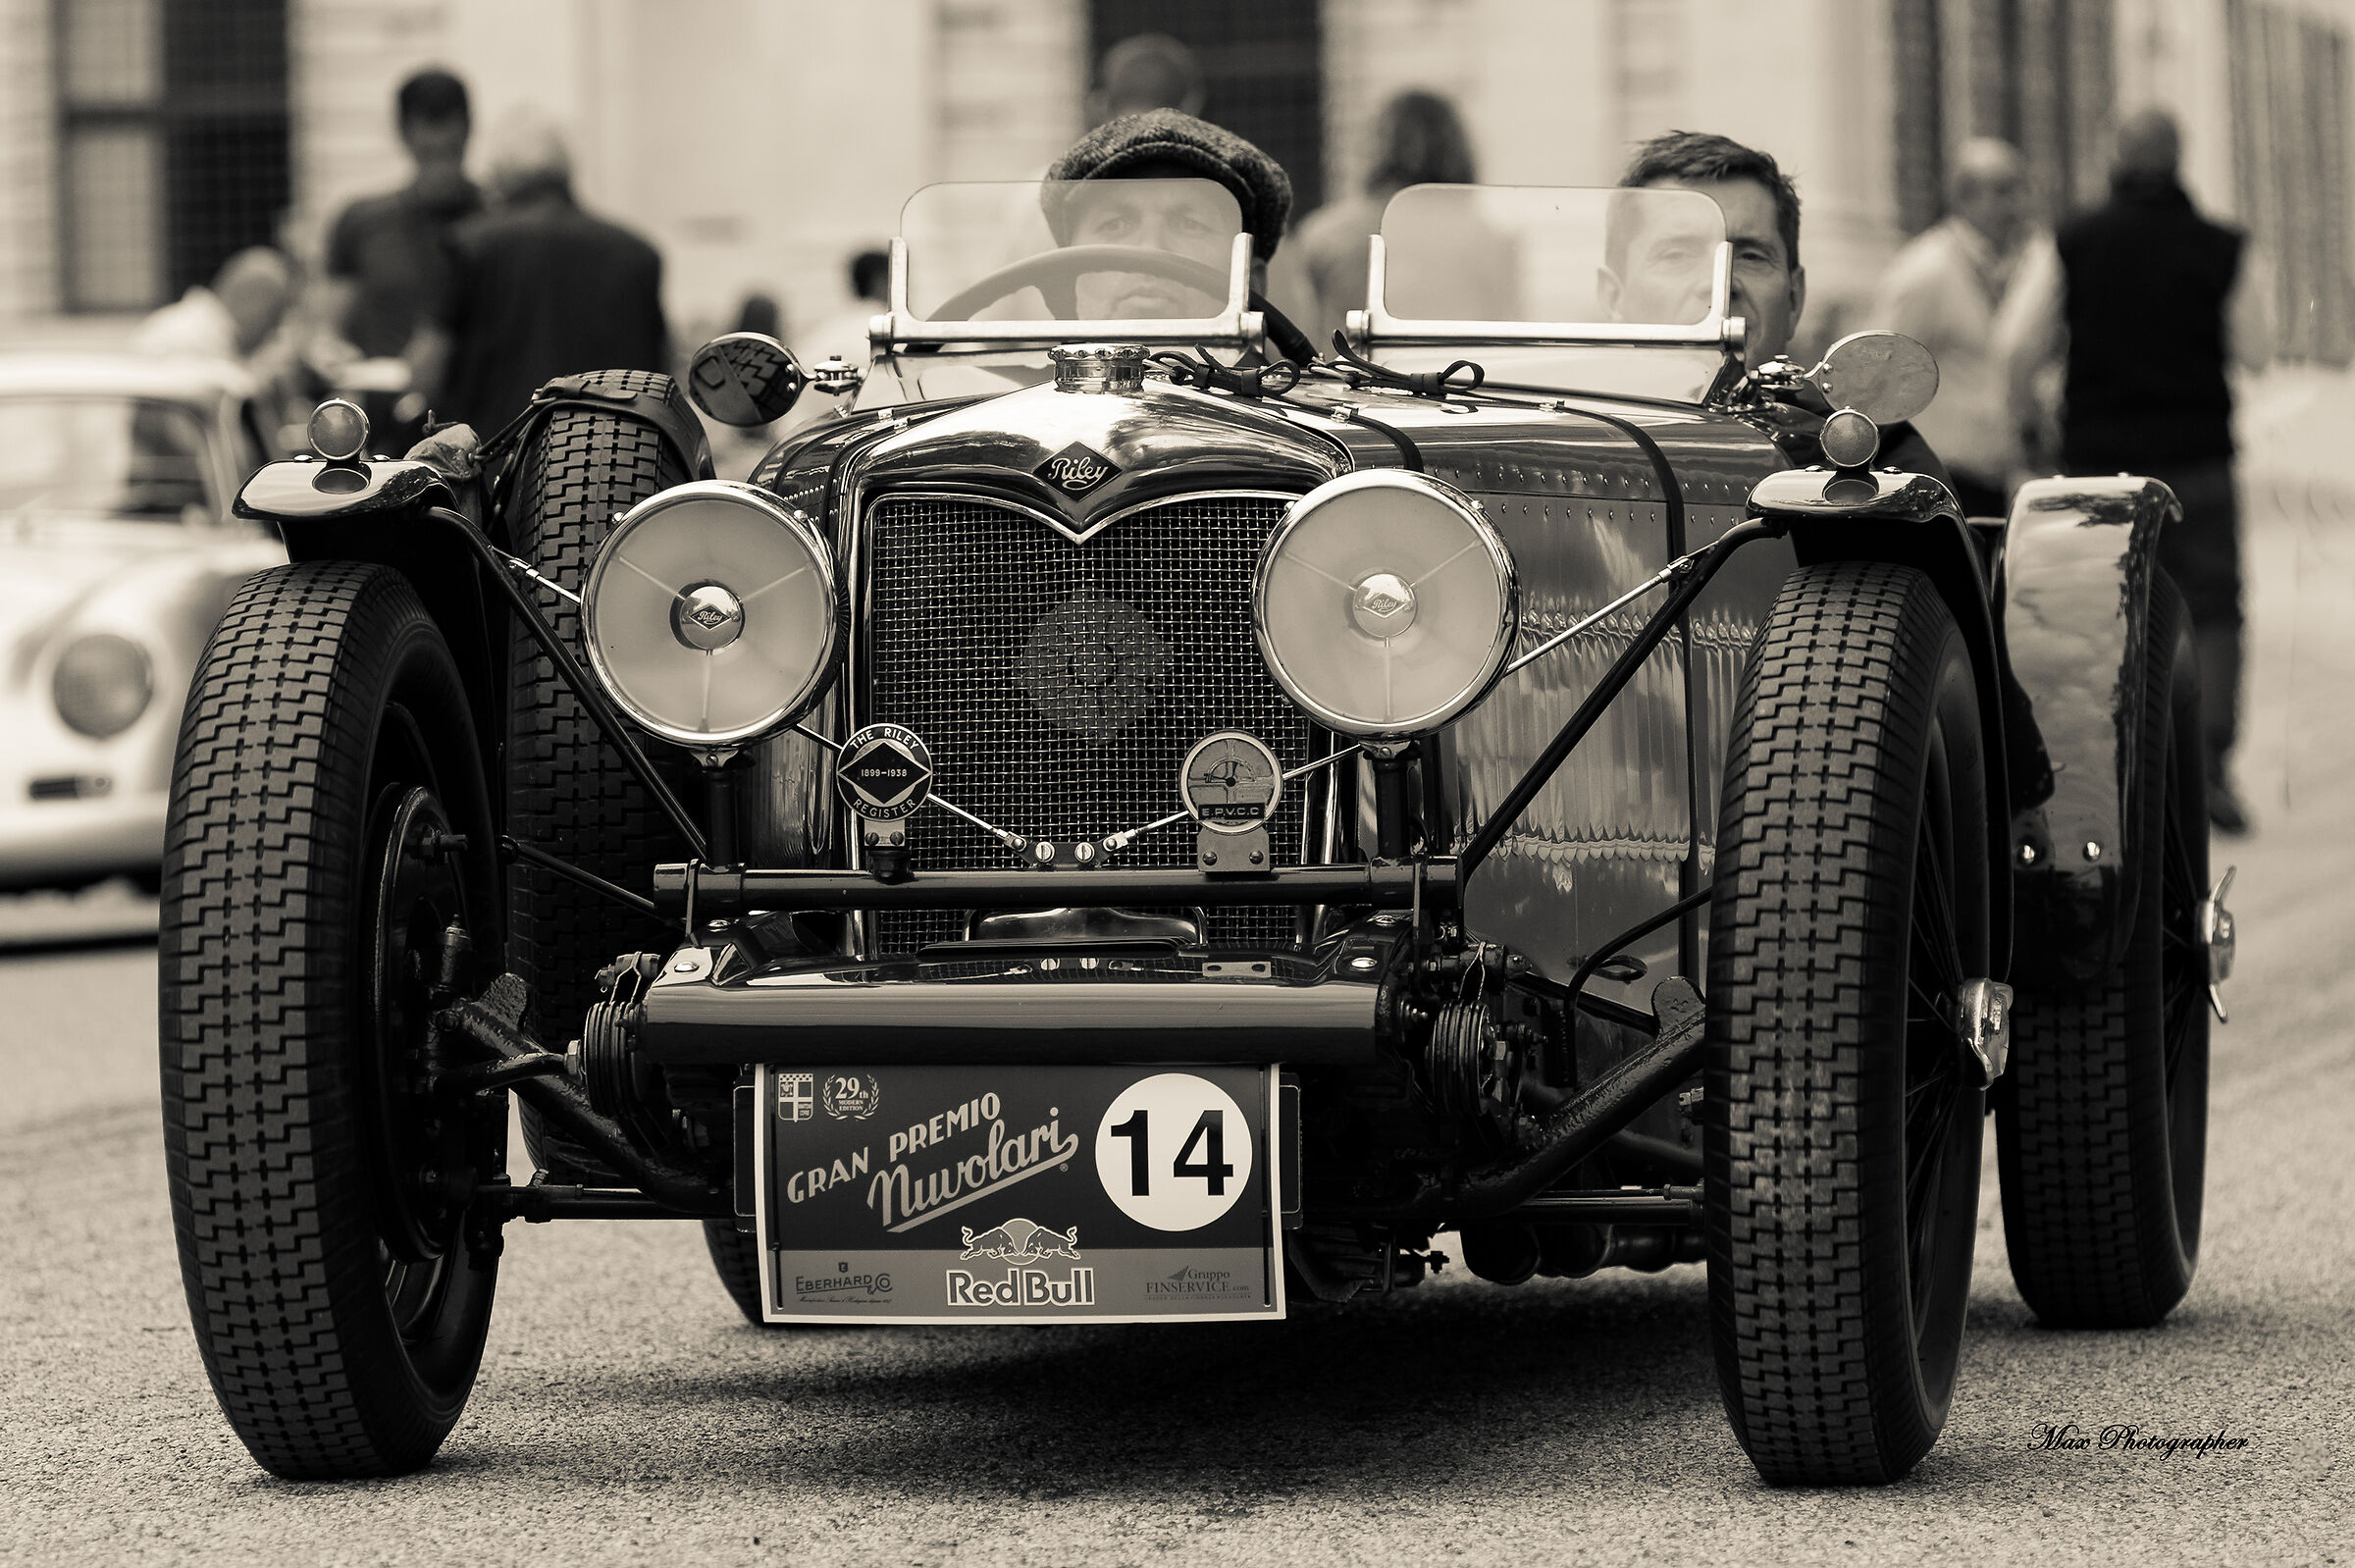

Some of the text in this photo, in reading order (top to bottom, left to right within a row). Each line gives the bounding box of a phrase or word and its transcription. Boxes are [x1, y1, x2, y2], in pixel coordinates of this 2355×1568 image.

[1047, 456, 1109, 491] Riley
[1372, 599, 1397, 613] Riley
[697, 610, 723, 625] Riley
[850, 727, 919, 750] THE RILEY
[861, 768, 908, 777] 1899-1938
[853, 798, 916, 818] REGISTER
[787, 1091, 1001, 1205] GRAN PREMIO
[1110, 1109, 1234, 1197] 14
[866, 1106, 1079, 1232] Nuvolari
[796, 1275, 872, 1292] EBERHARD
[1187, 1269, 1230, 1281] Gruppo
[946, 1267, 1095, 1307] Red Bull
